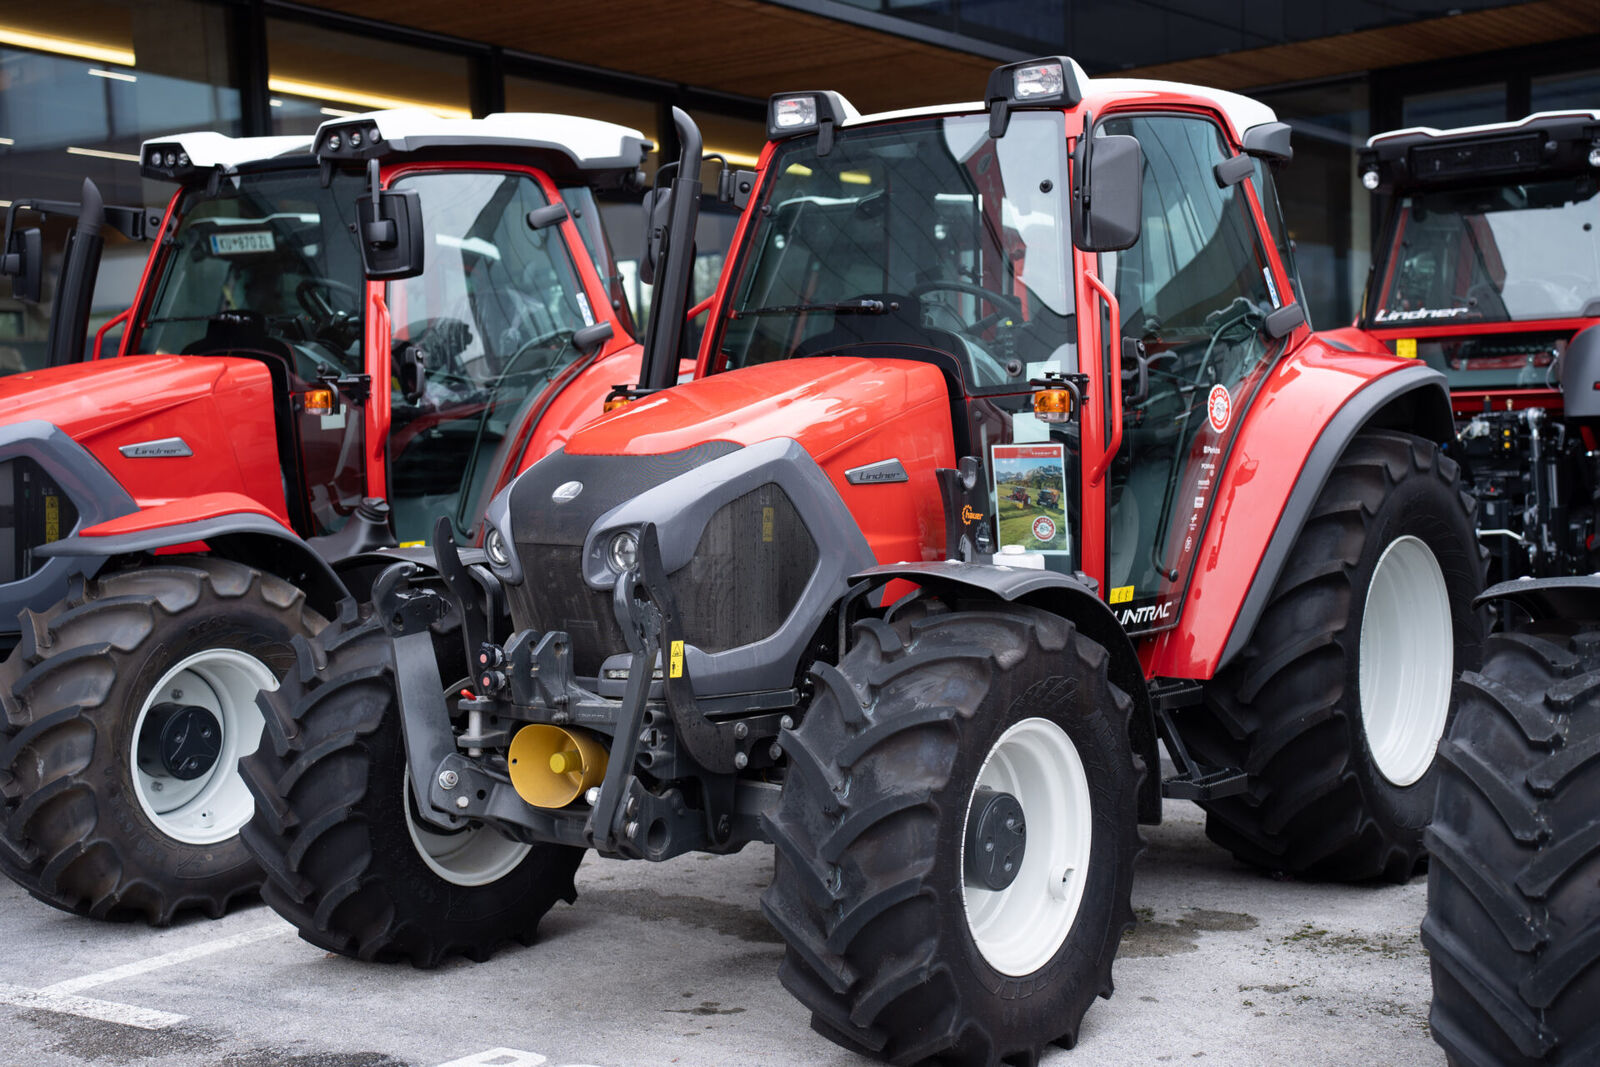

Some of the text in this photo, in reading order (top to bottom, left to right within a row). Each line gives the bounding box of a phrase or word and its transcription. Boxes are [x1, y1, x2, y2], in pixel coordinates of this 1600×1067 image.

[1375, 308, 1468, 322] Lindner
[134, 447, 182, 455] Lindner
[860, 471, 900, 480] Lindner
